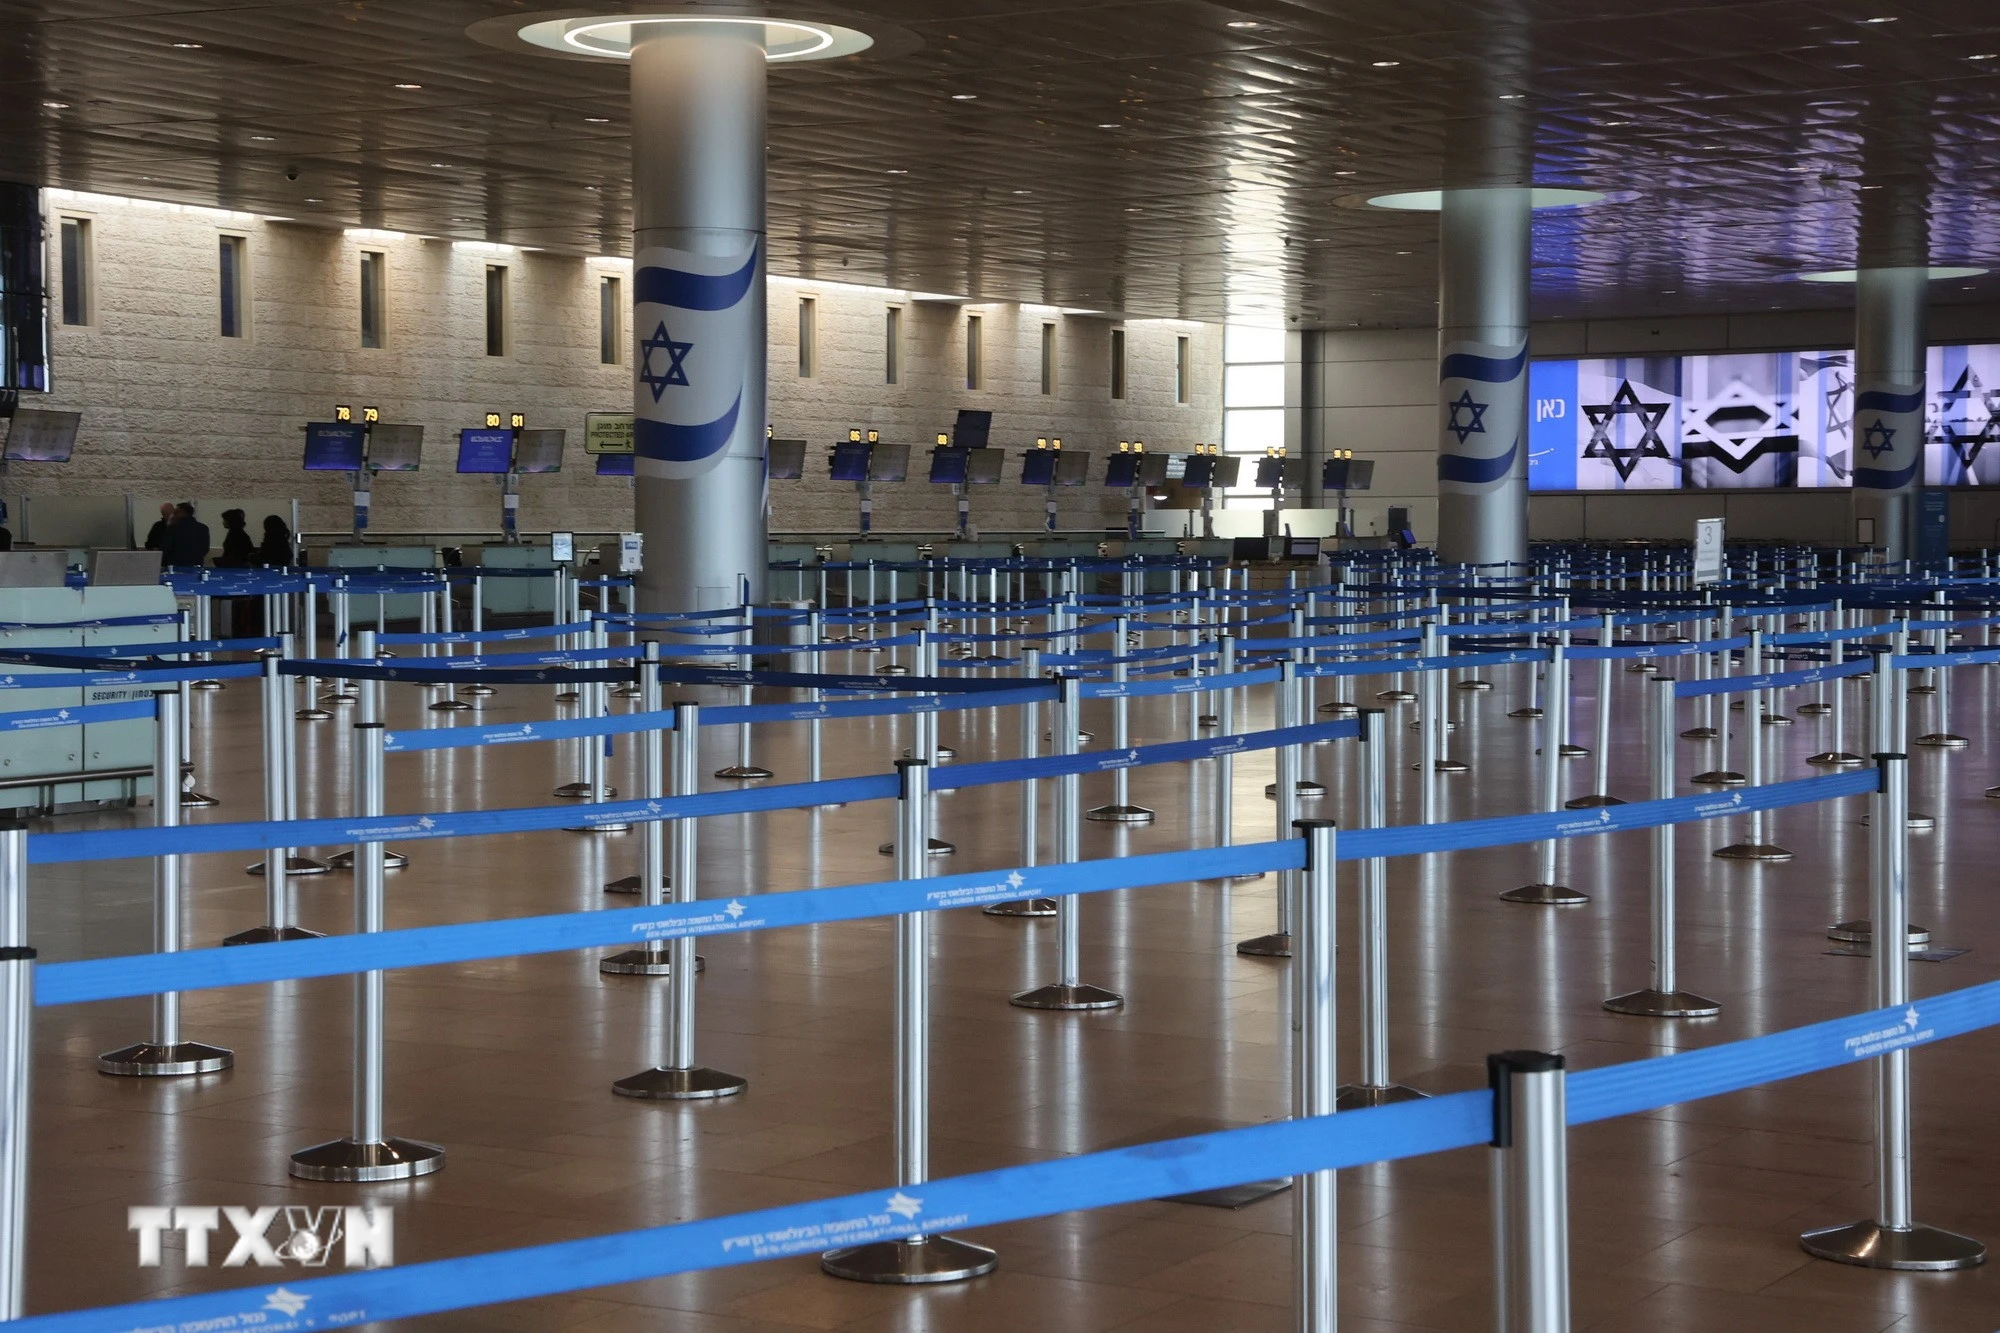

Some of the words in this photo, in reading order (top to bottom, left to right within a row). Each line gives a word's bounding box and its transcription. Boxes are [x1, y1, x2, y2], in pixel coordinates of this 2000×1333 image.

[336, 406, 350, 420] 78
[364, 408, 378, 422] 79
[1536, 398, 1566, 422] כאן
[486, 414, 500, 427] 80
[512, 415, 523, 427] 81
[850, 430, 860, 442] 86
[868, 431, 878, 442] 87
[1704, 526, 1712, 545] 3
[92, 691, 128, 700] SECURITY
[975, 891, 1018, 902] INTERNATIONAL
[646, 928, 687, 938] BEN-GURION
[688, 922, 738, 934] INTERNATIONAL
[738, 918, 766, 928] AIRPORT
